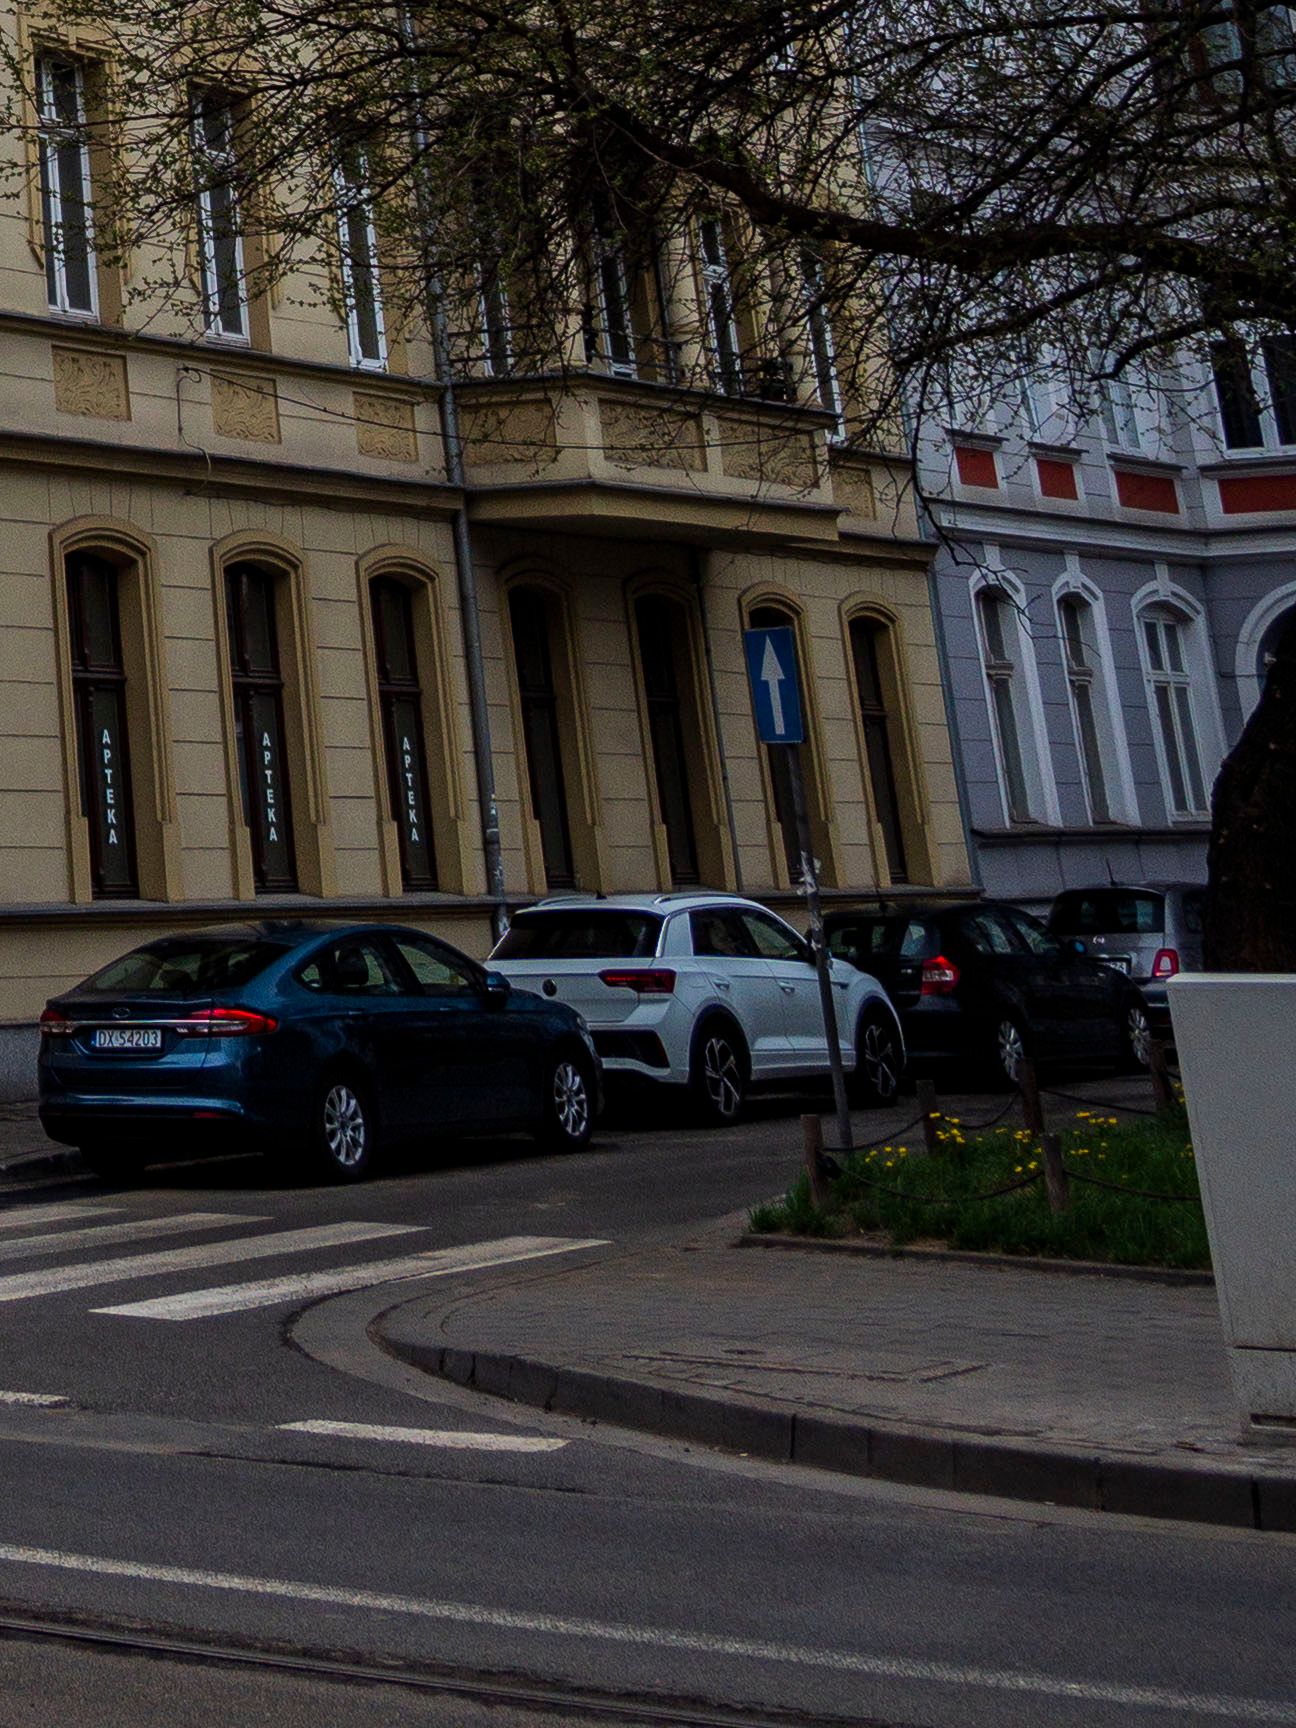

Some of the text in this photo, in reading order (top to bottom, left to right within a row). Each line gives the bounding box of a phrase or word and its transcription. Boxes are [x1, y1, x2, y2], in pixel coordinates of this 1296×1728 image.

[102, 729, 118, 844] APTEKA
[262, 732, 278, 842] APTEKA
[403, 736, 419, 842] APTEKA
[98, 1030, 114, 1046] DX
